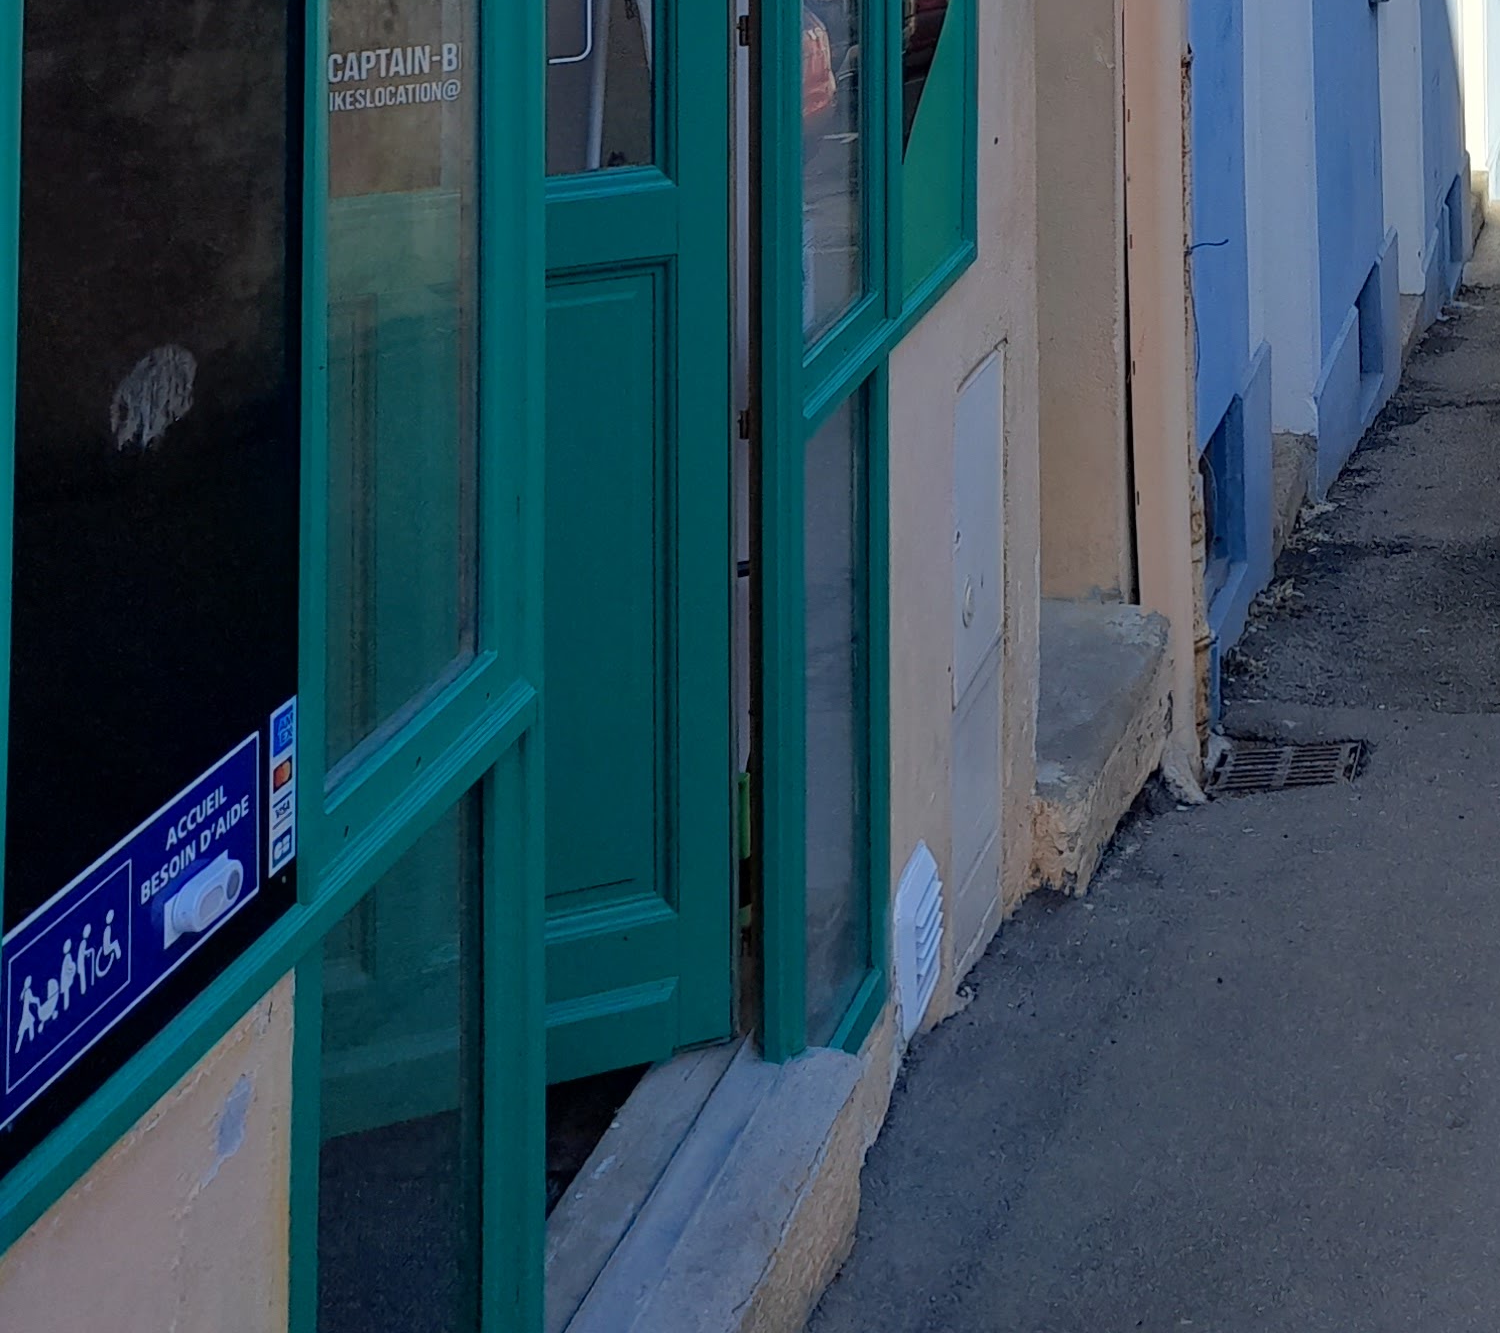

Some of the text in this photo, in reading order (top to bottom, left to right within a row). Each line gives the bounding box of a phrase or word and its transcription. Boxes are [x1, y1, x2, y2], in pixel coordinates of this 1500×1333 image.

[141, 794, 249, 905] BESOIN D'AIDE
[165, 785, 227, 851] ACCUEIL
